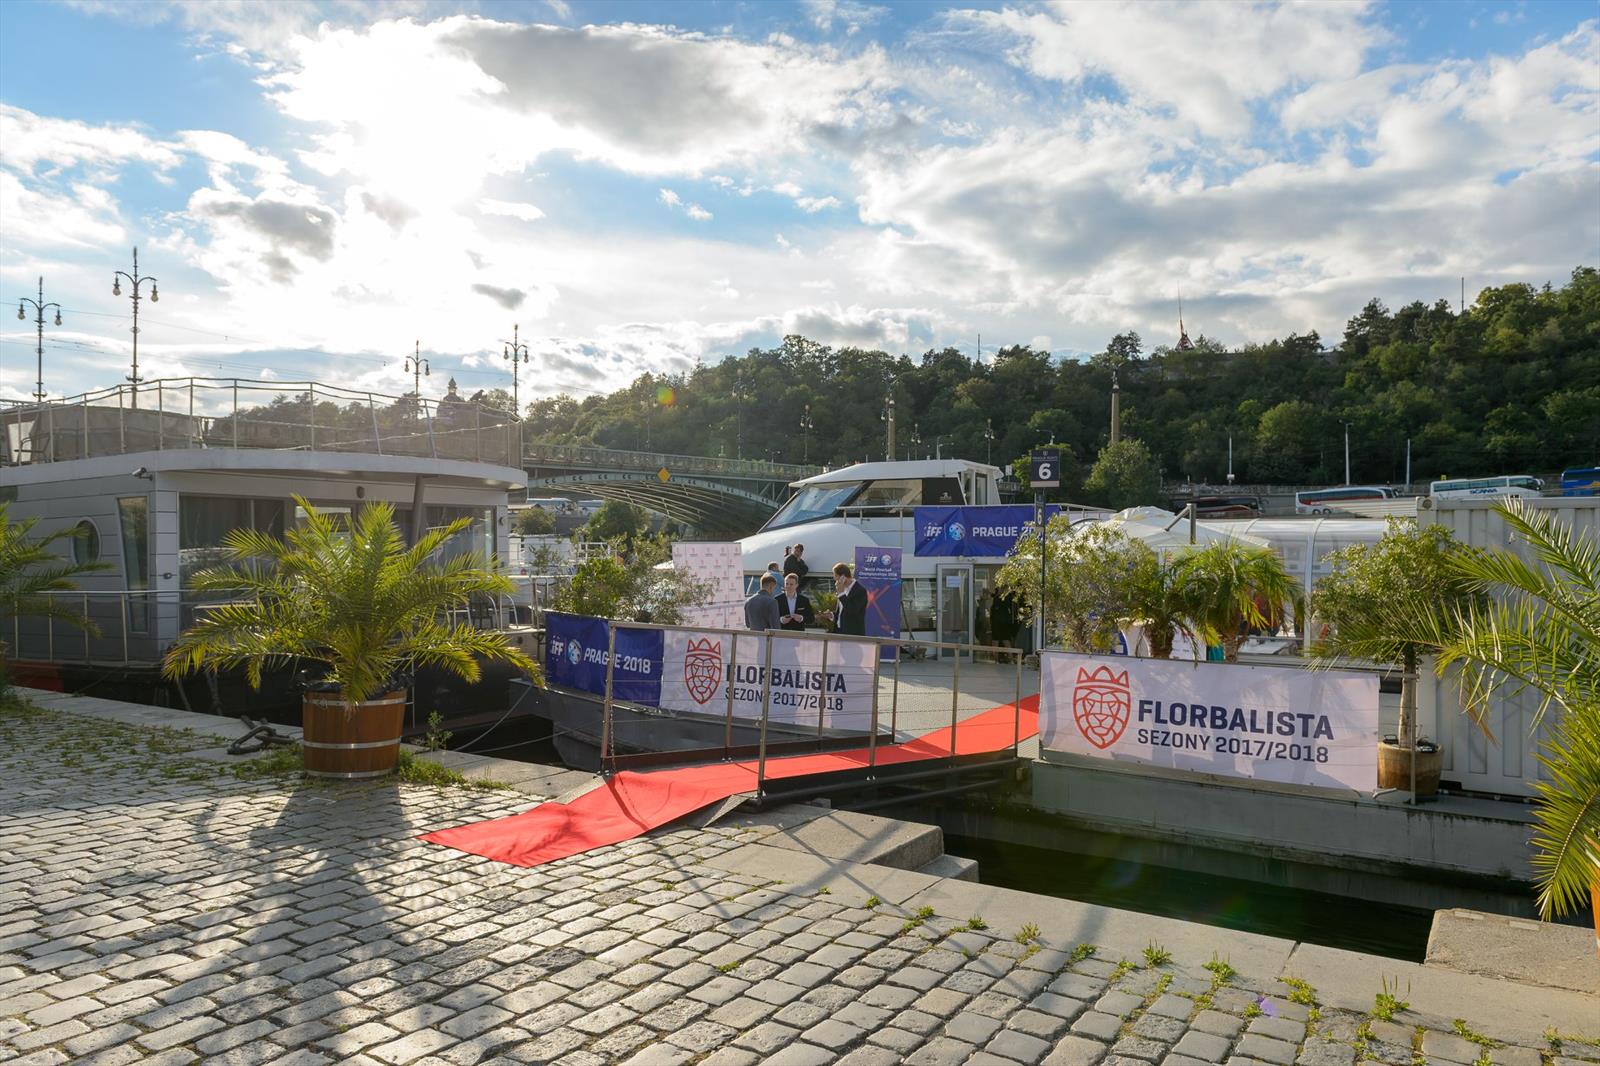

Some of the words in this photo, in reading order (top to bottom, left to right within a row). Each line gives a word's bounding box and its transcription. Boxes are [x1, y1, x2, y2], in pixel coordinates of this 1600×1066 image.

[1039, 463, 1051, 480] 6
[972, 526, 1018, 537] PRAGUE
[583, 648, 622, 669] PRAGE
[623, 655, 651, 674] 2018
[725, 687, 771, 703] SEZON
[773, 691, 843, 711] 2017/2018
[1138, 700, 1334, 740] FLORBALISTA
[1137, 729, 1211, 751] SEZONY
[1215, 737, 1329, 763] 2017/2018
